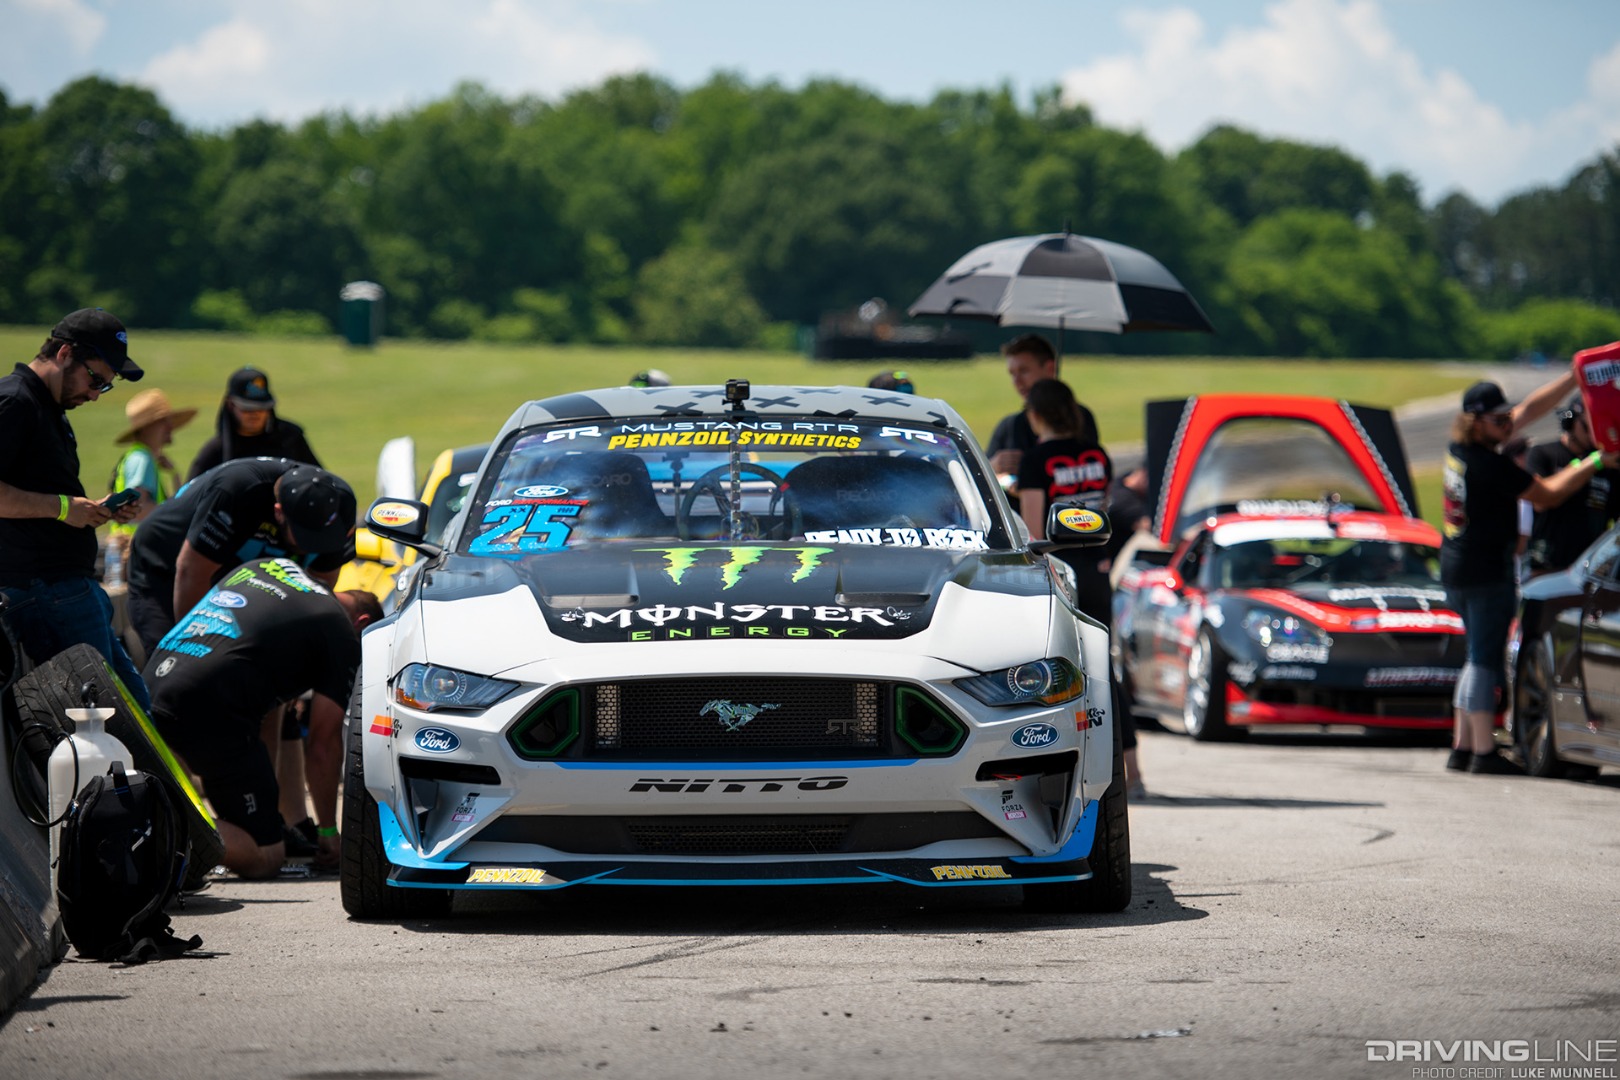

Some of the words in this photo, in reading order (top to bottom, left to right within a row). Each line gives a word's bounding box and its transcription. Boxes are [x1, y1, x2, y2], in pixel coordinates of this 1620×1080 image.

[621, 421, 783, 433] MUSTANG
[792, 422, 860, 434] RTR
[607, 431, 732, 451] PENNZOIL
[736, 431, 862, 449] SYNTHETICS
[485, 499, 513, 507] FORD
[1065, 513, 1096, 524] PENNZOIL
[468, 505, 582, 553] 25
[583, 602, 895, 630] MONSTER
[631, 626, 848, 641] ENERGY
[419, 730, 451, 751] Ford
[1020, 724, 1051, 745] Ford
[628, 776, 849, 792] NITTO
[1001, 803, 1024, 812] FORZA
[466, 868, 547, 884] PENNZOIL
[931, 864, 1012, 880] PENNZOIL
